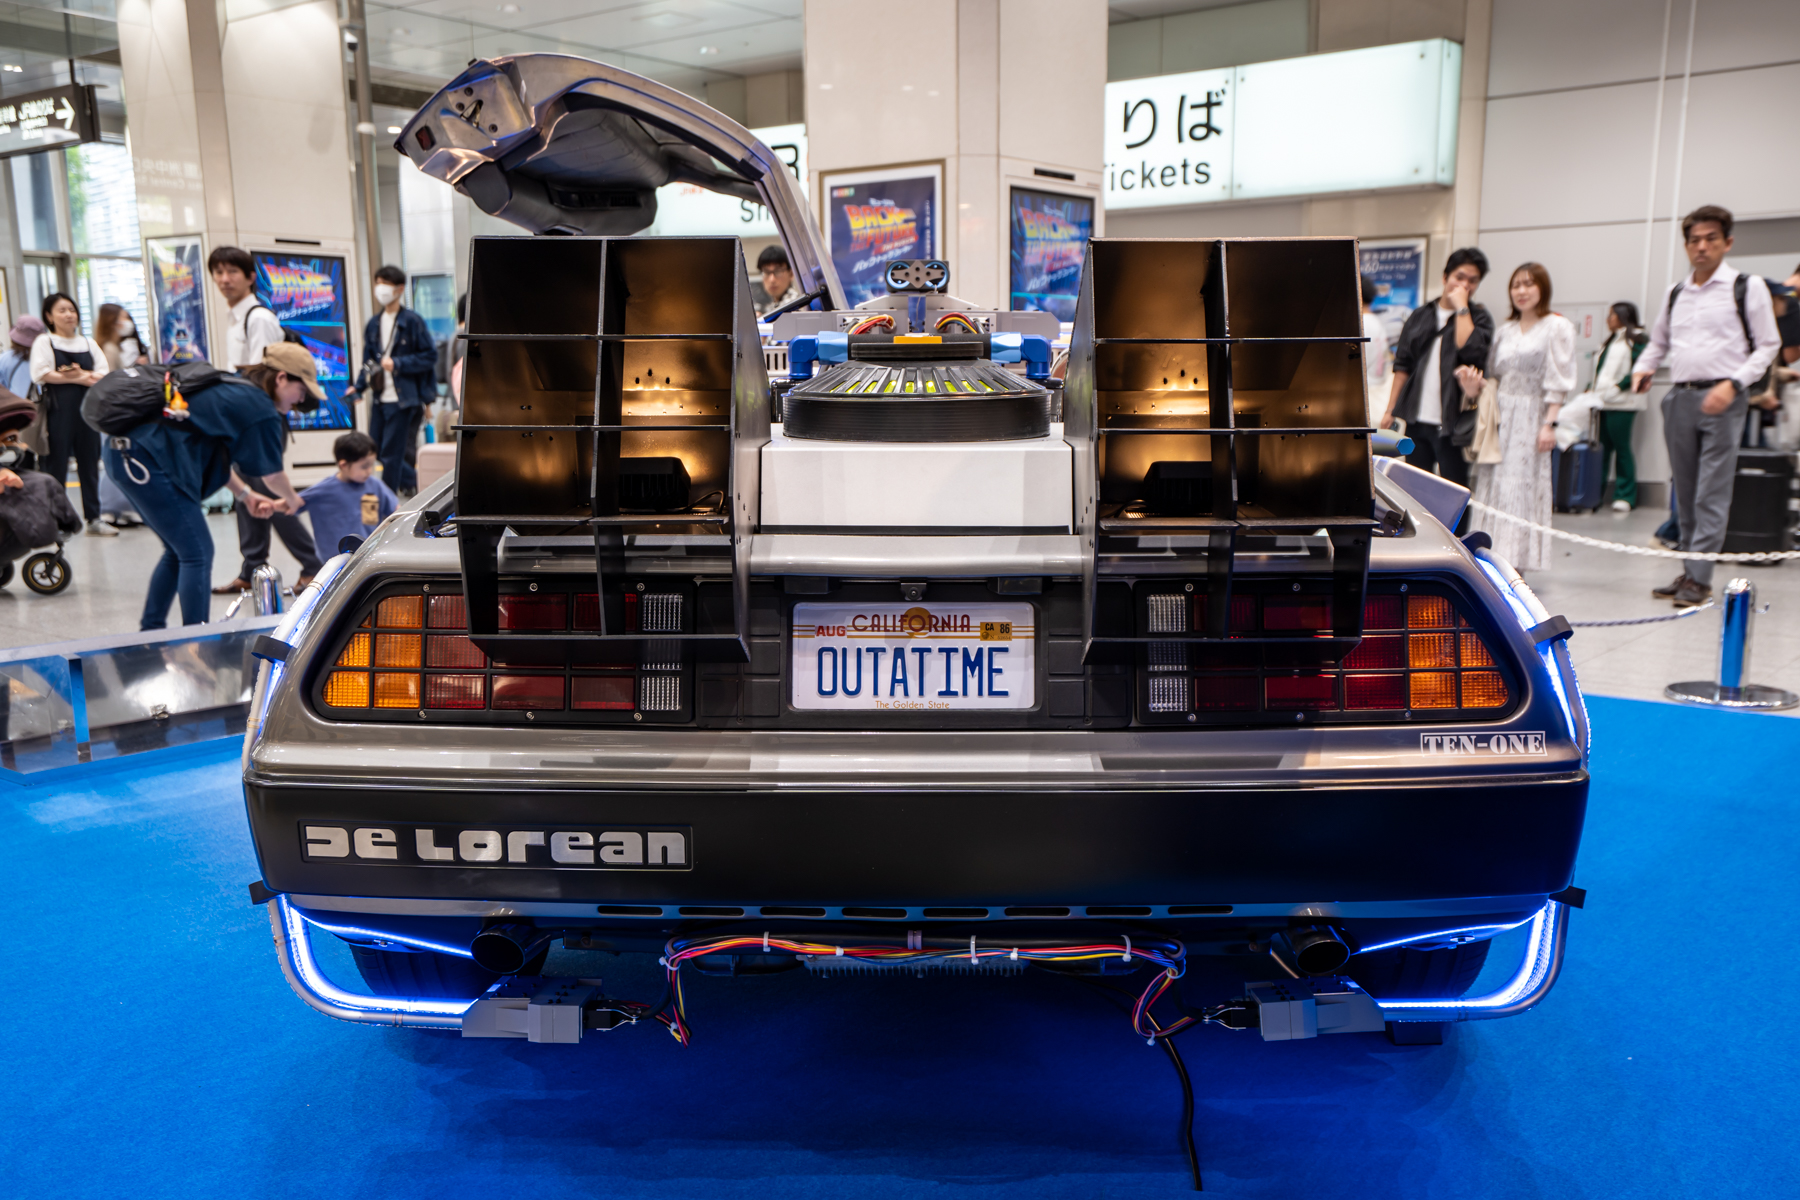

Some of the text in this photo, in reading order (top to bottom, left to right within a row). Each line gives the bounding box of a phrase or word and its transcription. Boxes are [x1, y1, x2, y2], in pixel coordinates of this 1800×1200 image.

[1122, 88, 1226, 149] りば
[1104, 159, 1210, 191] ickets
[843, 204, 917, 230] BACK
[866, 221, 917, 248] FUTURE
[261, 262, 333, 288] BACK
[815, 625, 847, 637] AUG
[851, 614, 971, 633] CALIFORNIA
[985, 622, 1010, 634] CA 86
[817, 646, 1010, 697] OUTATIME
[875, 700, 950, 709] The Golden State
[1424, 734, 1544, 755] TEN-ONE
